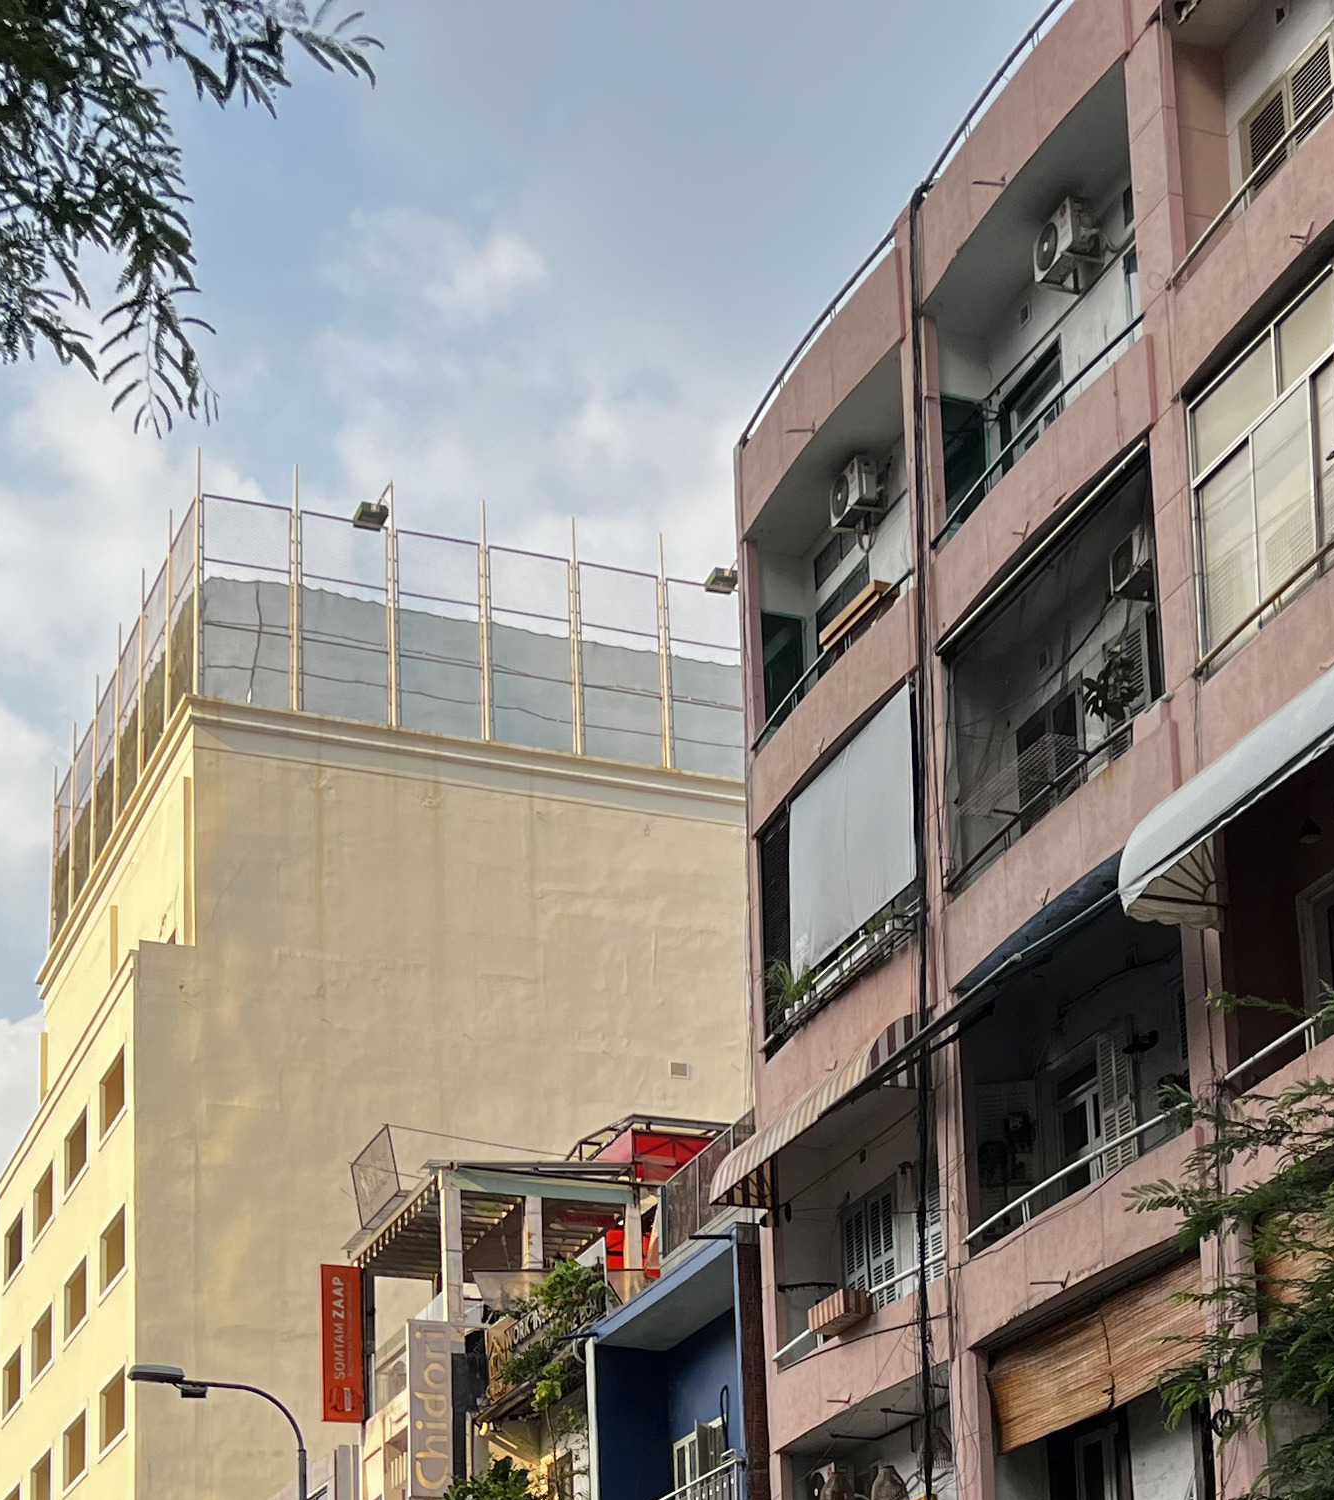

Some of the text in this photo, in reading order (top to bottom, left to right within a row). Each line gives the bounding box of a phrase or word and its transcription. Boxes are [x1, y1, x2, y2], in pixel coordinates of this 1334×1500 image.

[331, 1276, 346, 1380] SOMTAM ZAAP
[415, 1330, 449, 1490] Chidori
